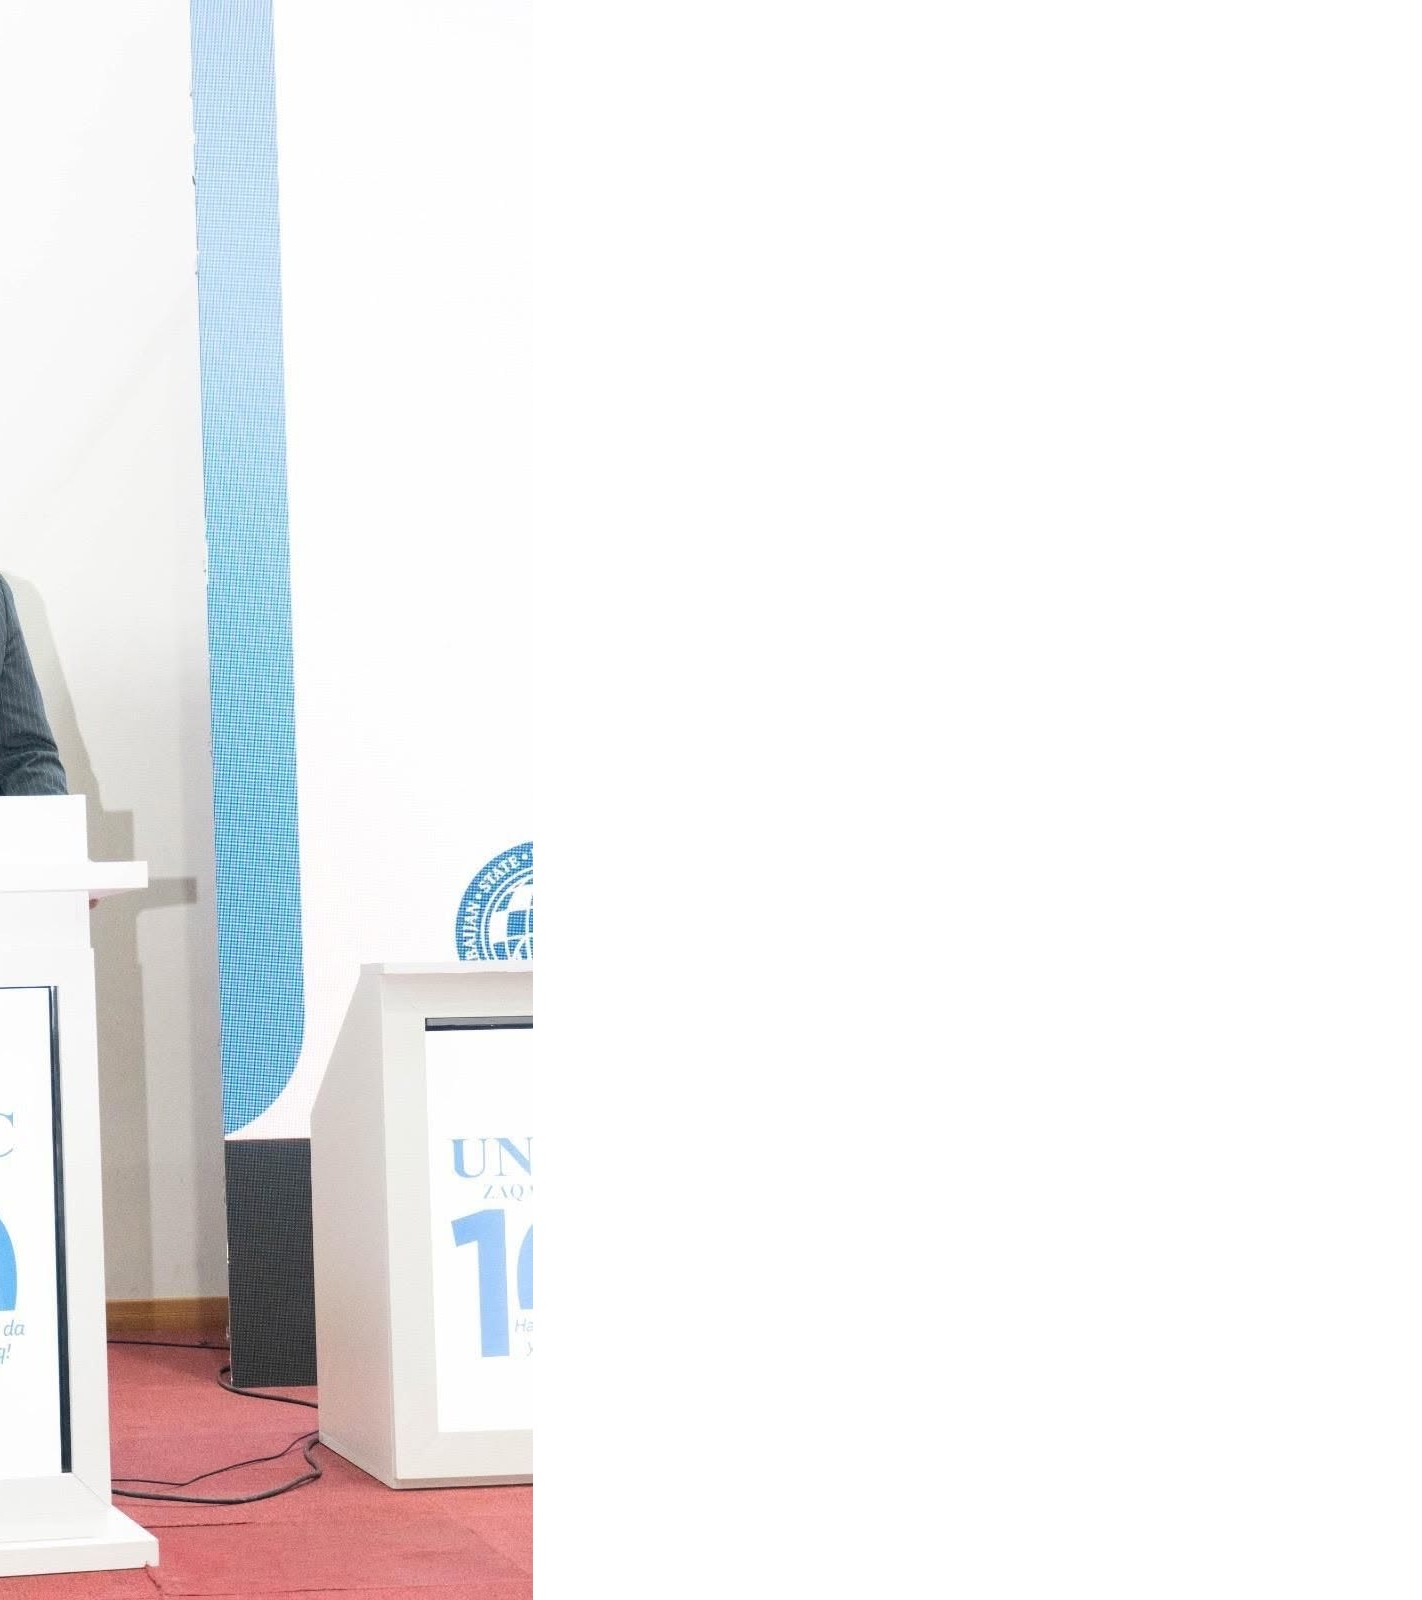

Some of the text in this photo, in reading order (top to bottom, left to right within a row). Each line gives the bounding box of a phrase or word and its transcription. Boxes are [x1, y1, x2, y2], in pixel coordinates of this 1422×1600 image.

[480, 855, 519, 891] STATE
[450, 1136, 533, 1178] UN
[483, 1184, 533, 1202] ZAQ
[450, 1208, 533, 1357] 1
[3, 1319, 25, 1337] da
